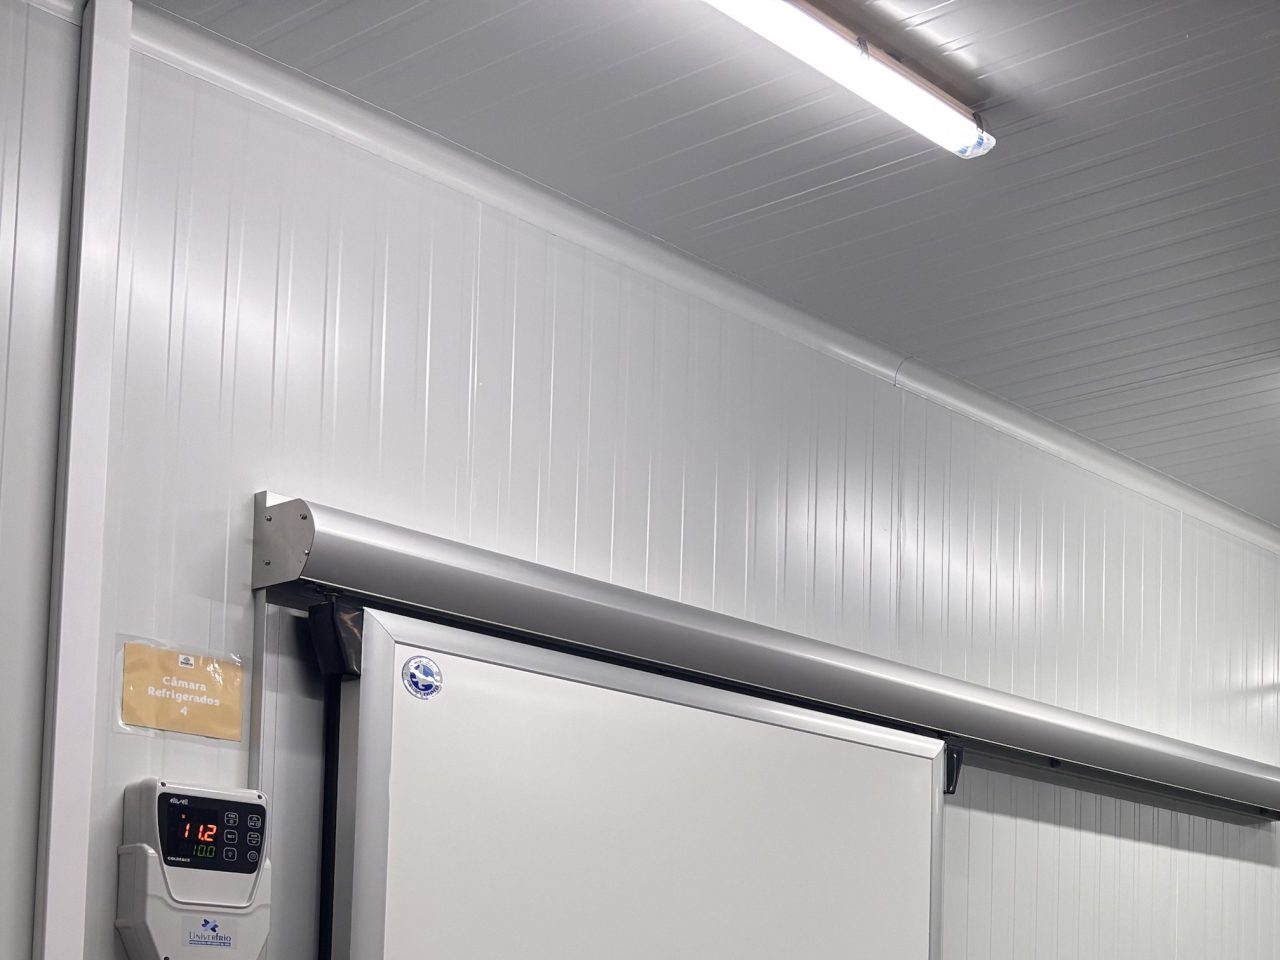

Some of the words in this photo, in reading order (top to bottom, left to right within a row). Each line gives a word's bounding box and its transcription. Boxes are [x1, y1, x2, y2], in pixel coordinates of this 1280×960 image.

[162, 676, 206, 691] Câmara
[147, 686, 220, 706] Refrigerados
[180, 706, 188, 716] 4
